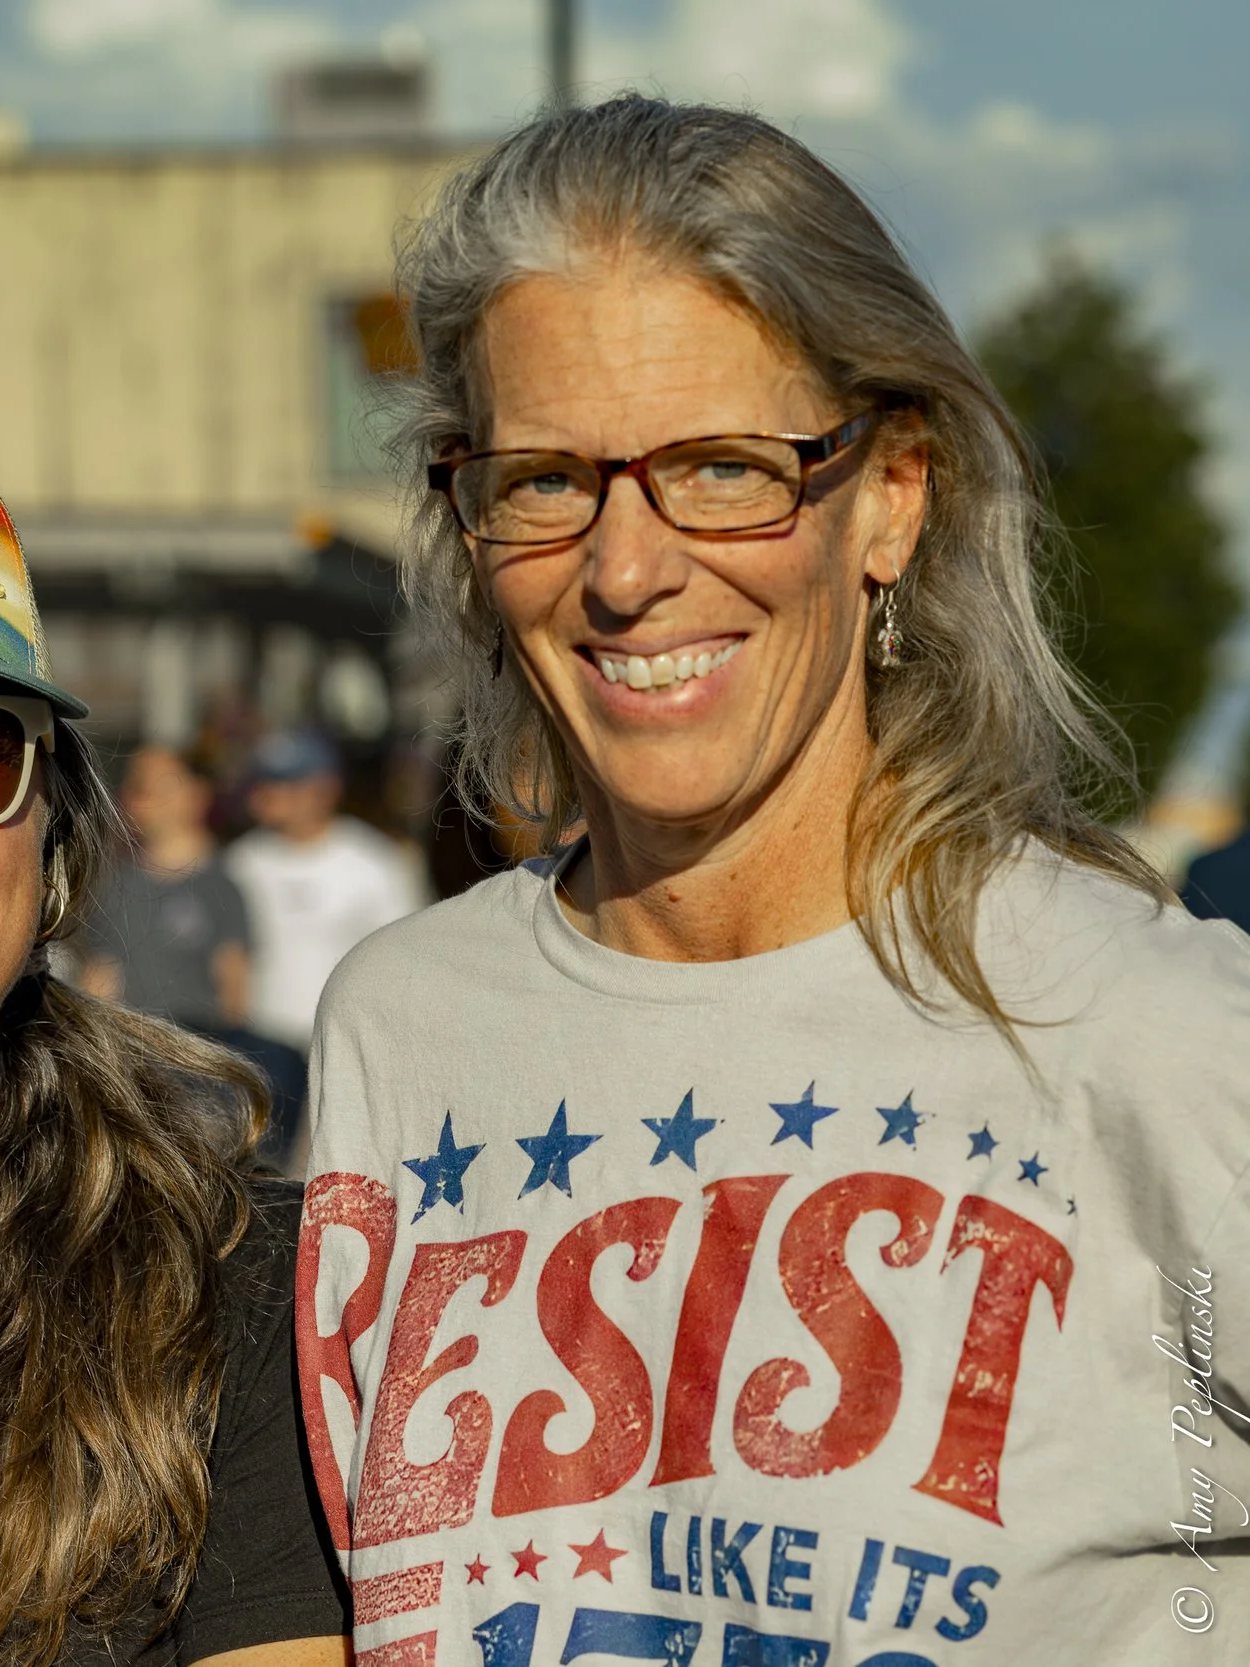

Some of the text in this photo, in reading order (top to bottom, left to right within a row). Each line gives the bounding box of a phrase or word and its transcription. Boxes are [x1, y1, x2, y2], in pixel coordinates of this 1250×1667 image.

[294, 1171, 1075, 1552] RESIST
[649, 1510, 820, 1612] LIKE
[847, 1537, 1002, 1643] ITS
